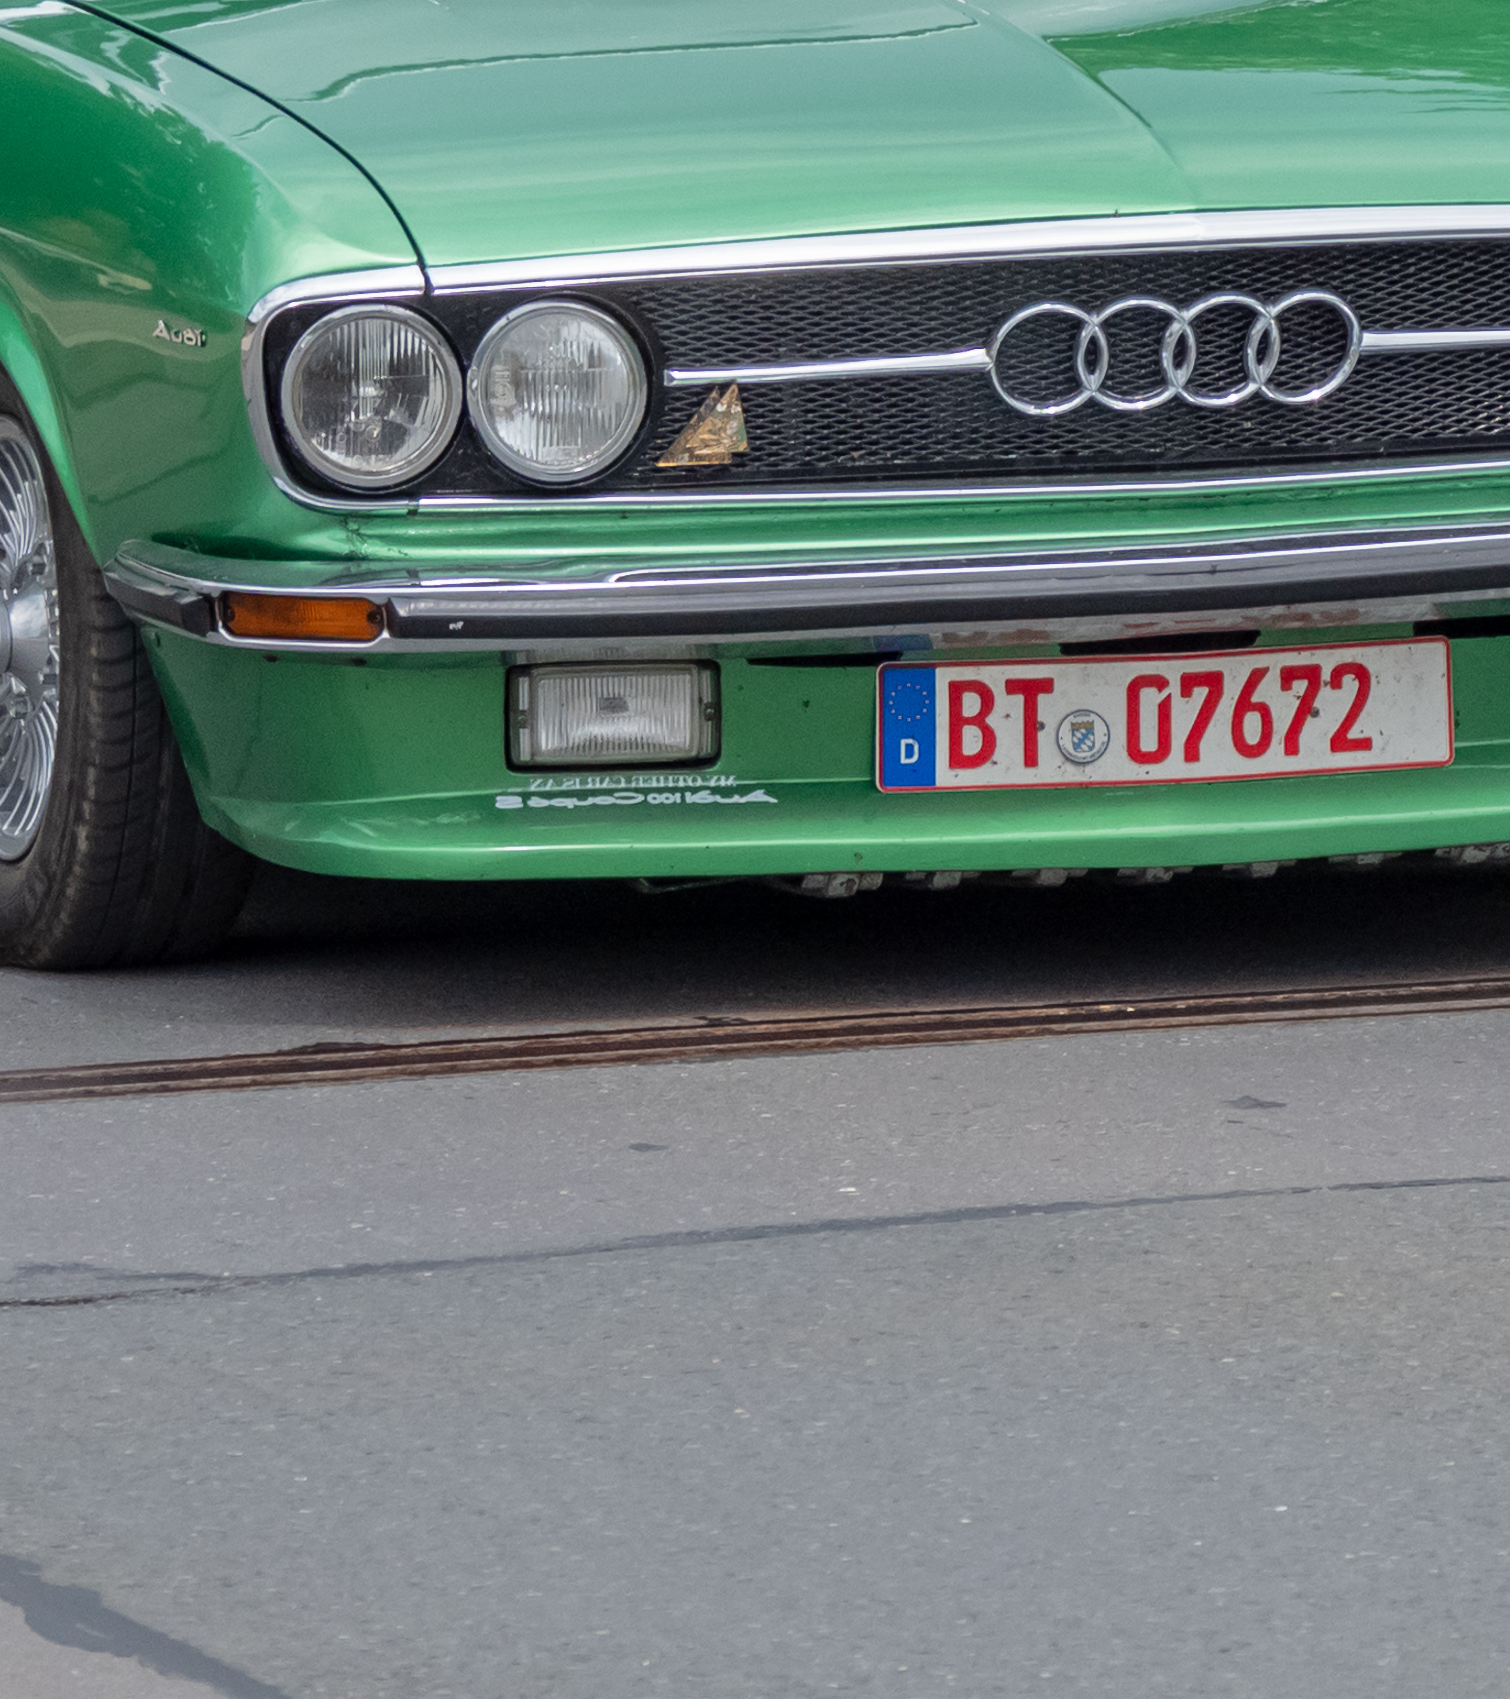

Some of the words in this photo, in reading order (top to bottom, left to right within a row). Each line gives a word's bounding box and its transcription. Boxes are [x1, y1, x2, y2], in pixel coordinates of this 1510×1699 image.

[152, 319, 203, 347] Audi
[900, 738, 919, 764] D
[948, 677, 1054, 770] BT
[1126, 662, 1372, 765] 07672
